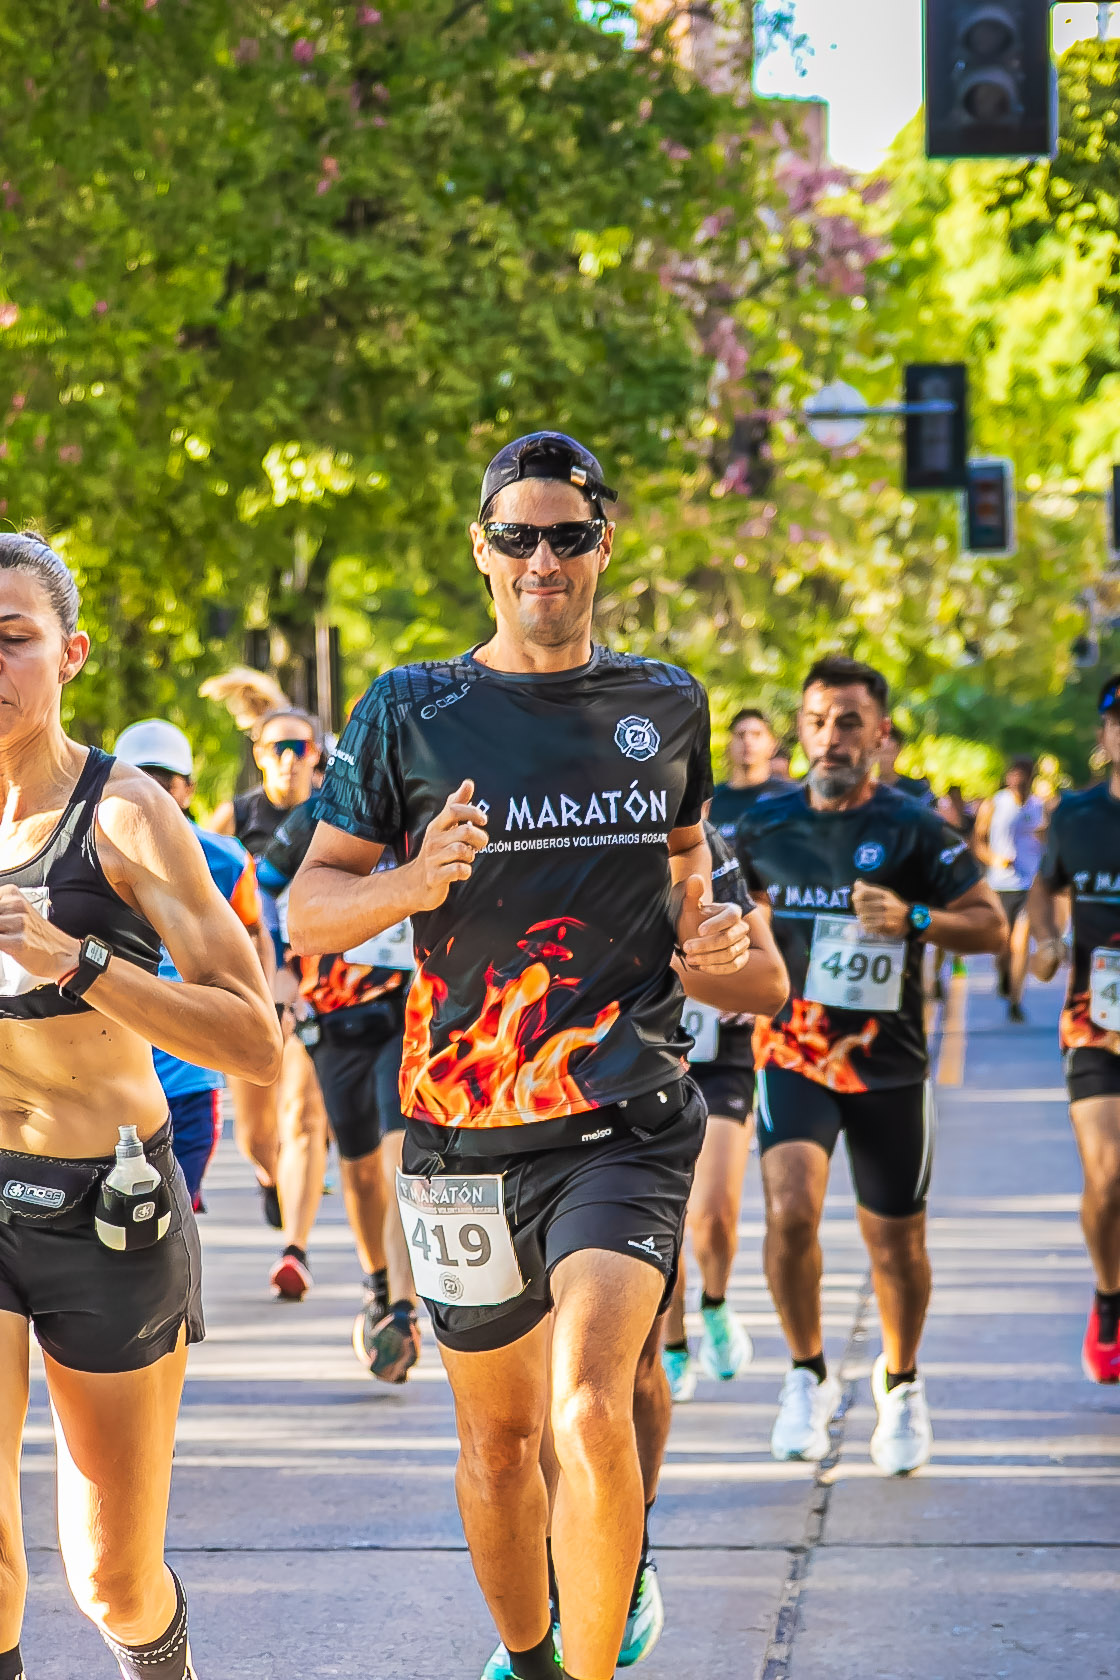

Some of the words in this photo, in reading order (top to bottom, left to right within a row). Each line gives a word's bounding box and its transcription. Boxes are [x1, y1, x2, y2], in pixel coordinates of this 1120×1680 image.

[505, 780, 666, 831] MARATÓN
[513, 837, 570, 851] BOMBEROS
[572, 834, 639, 847] VOLUNTARIOS
[785, 885, 851, 908] MARAT
[821, 951, 892, 985] 490
[410, 1182, 483, 1204] MARATÓN
[412, 1218, 492, 1267] 419
